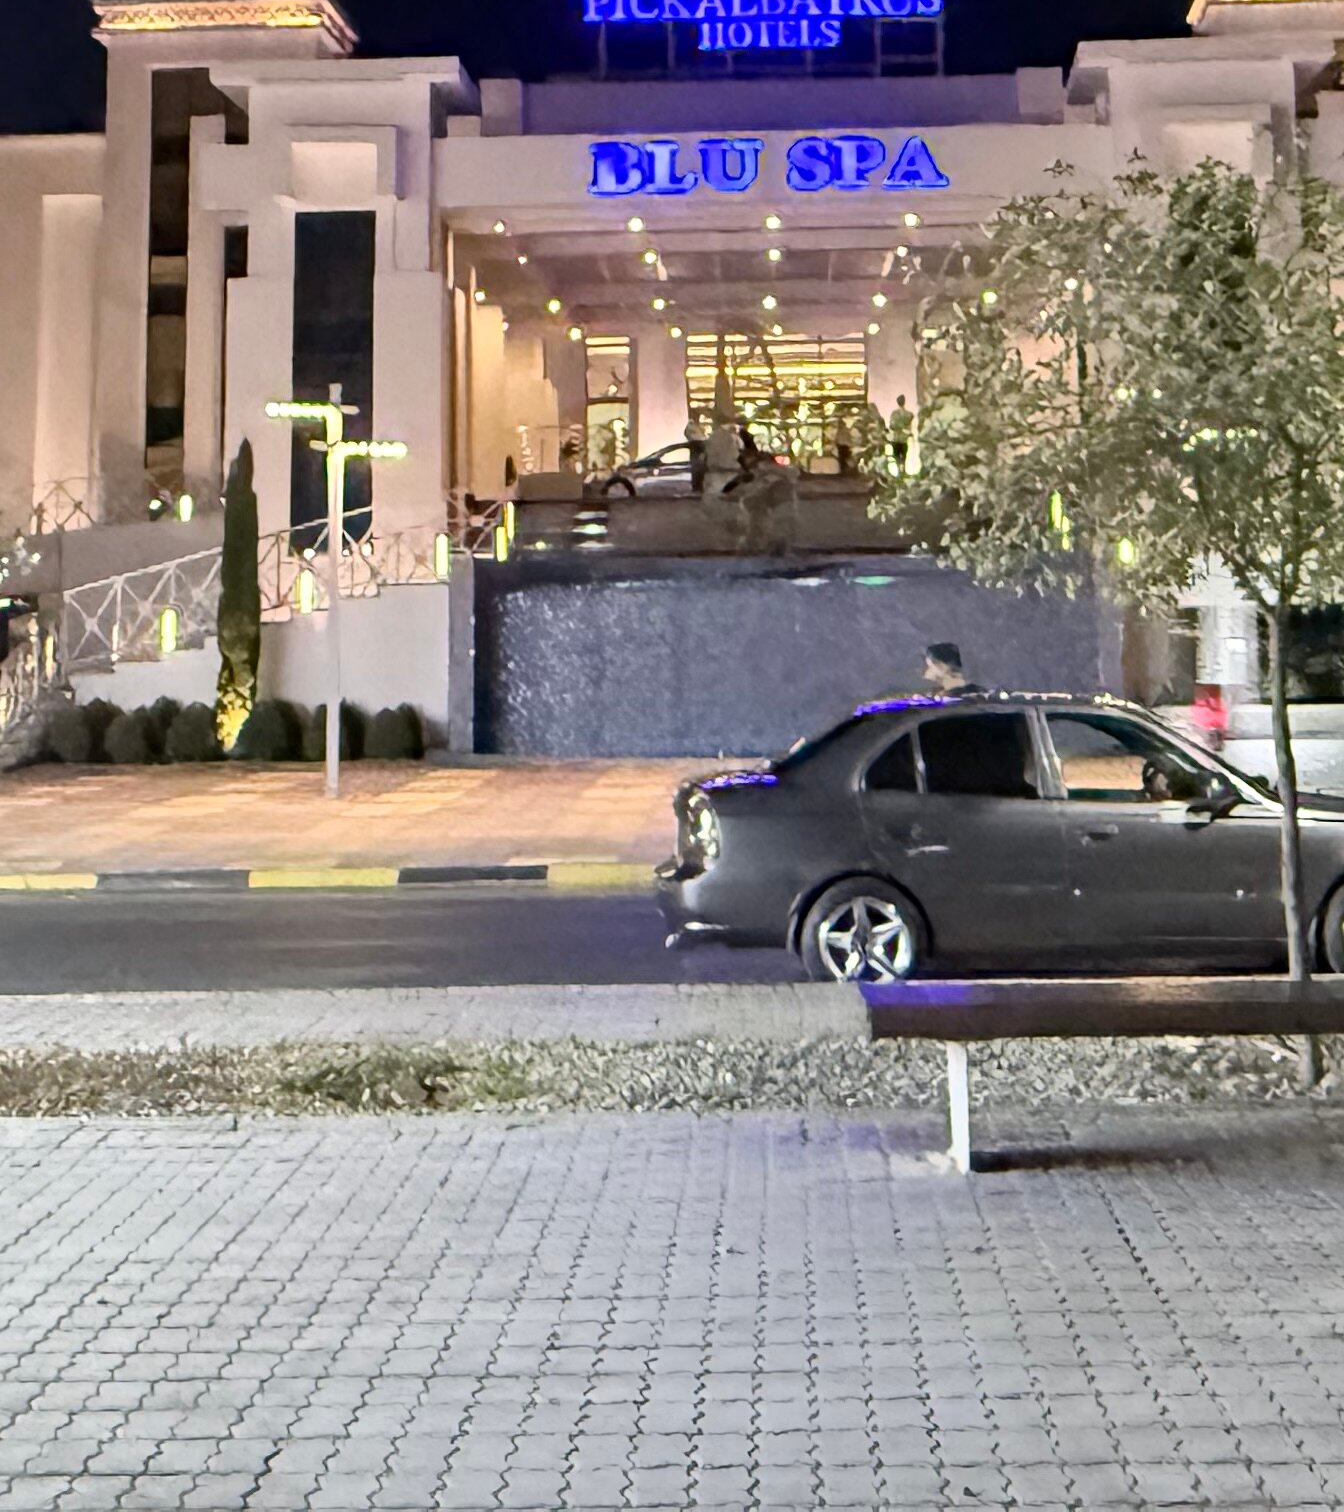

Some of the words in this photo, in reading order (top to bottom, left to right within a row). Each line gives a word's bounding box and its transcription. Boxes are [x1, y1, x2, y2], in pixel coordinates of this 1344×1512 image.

[697, 19, 841, 51] HOTELS
[587, 140, 763, 196] BLU
[785, 134, 950, 192] SPA
